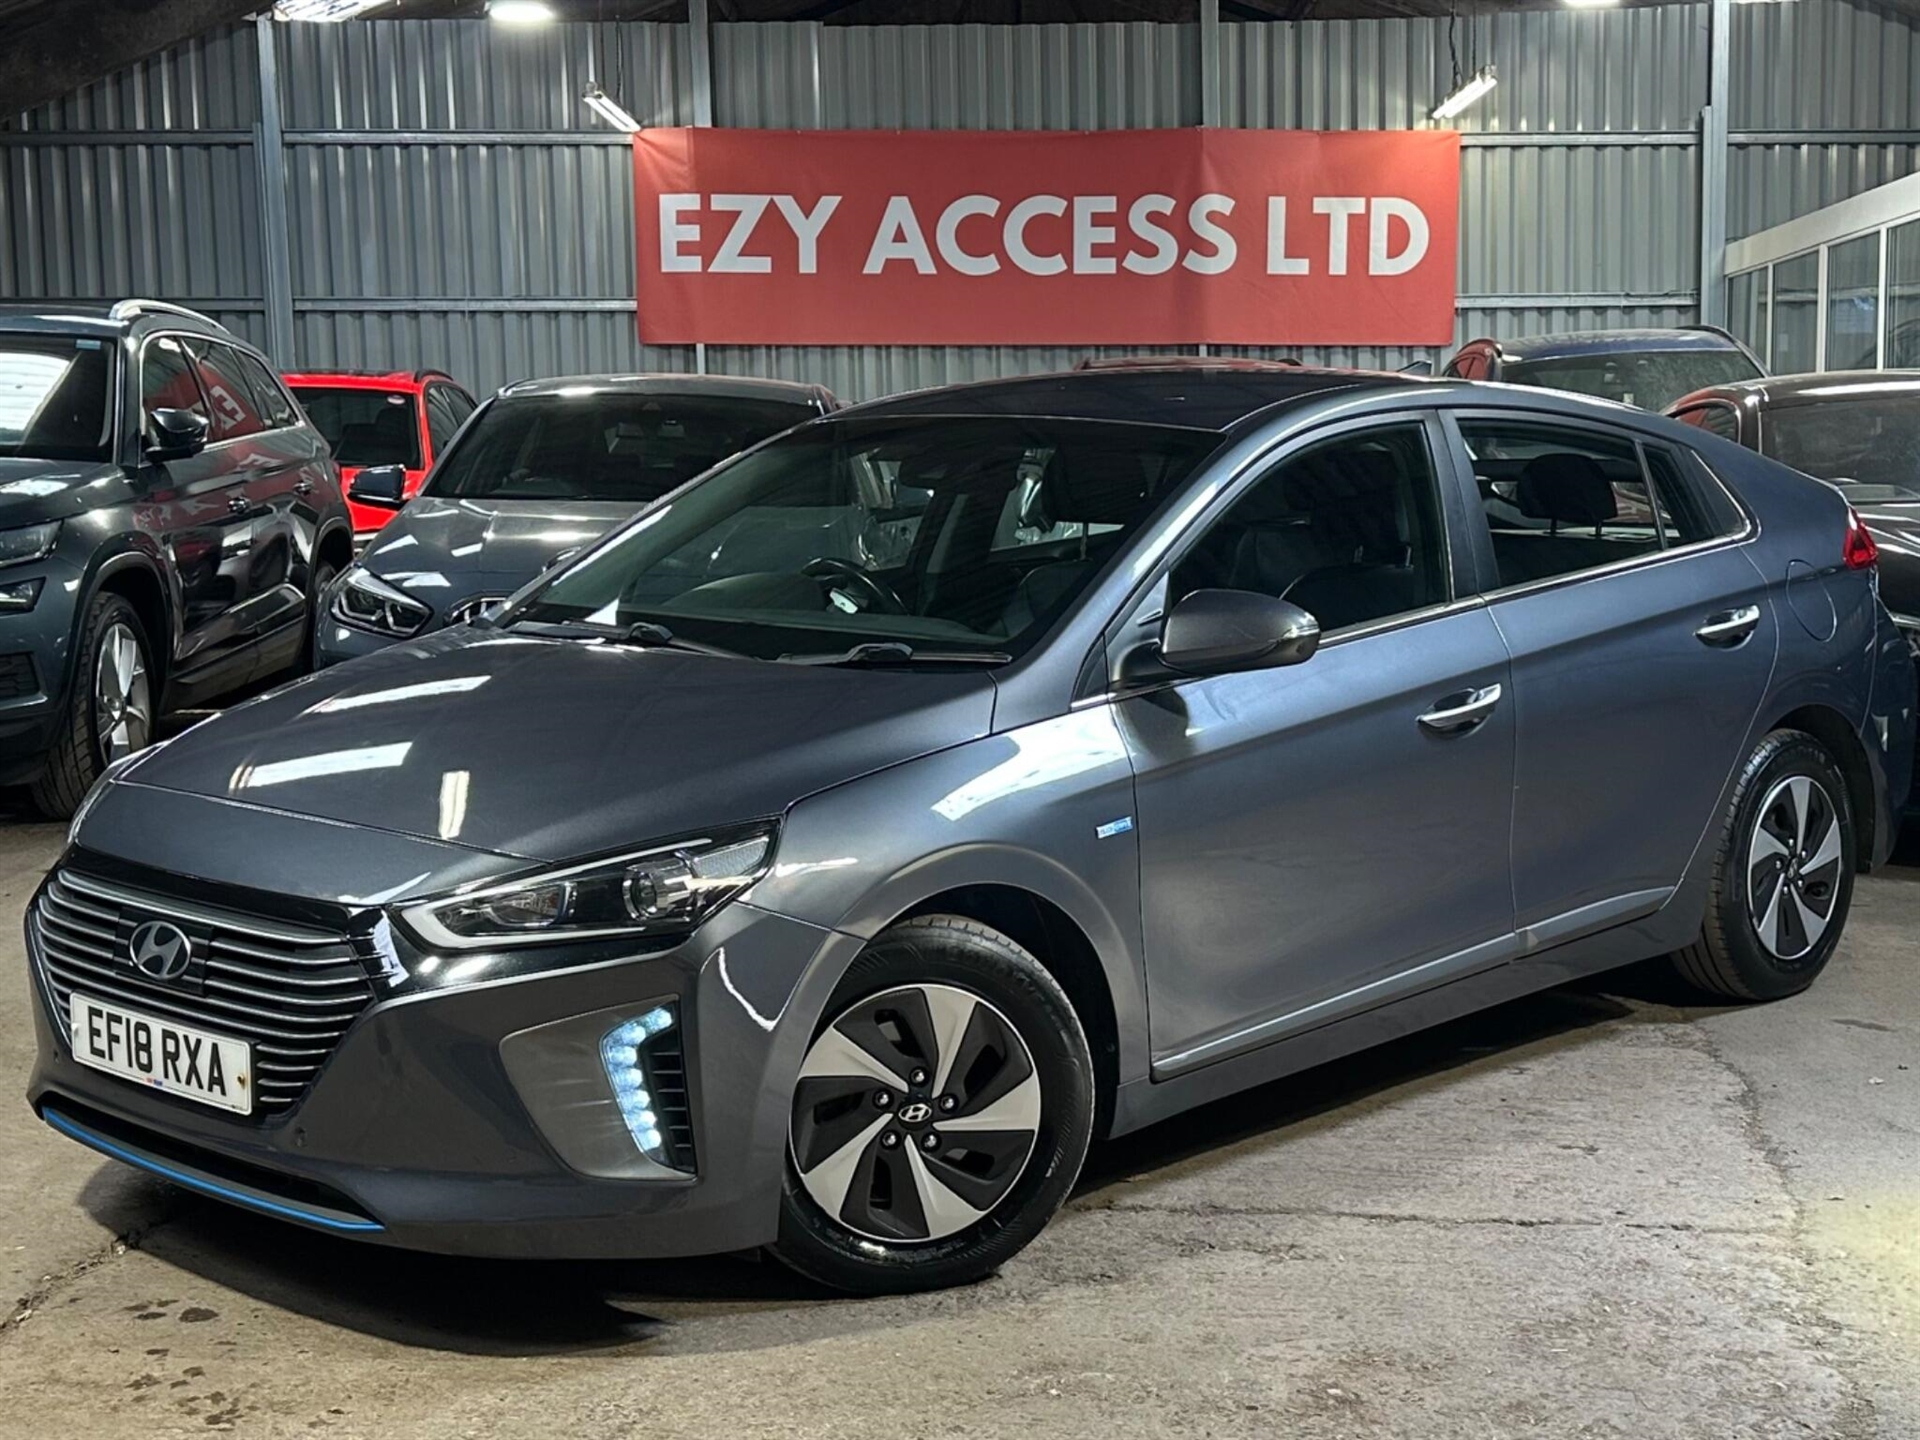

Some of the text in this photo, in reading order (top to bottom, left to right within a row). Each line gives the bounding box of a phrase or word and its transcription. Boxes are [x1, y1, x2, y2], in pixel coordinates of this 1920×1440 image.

[658, 193, 1430, 276] EZY ACCESS LTD
[87, 1005, 227, 1097] EF18 RXA
